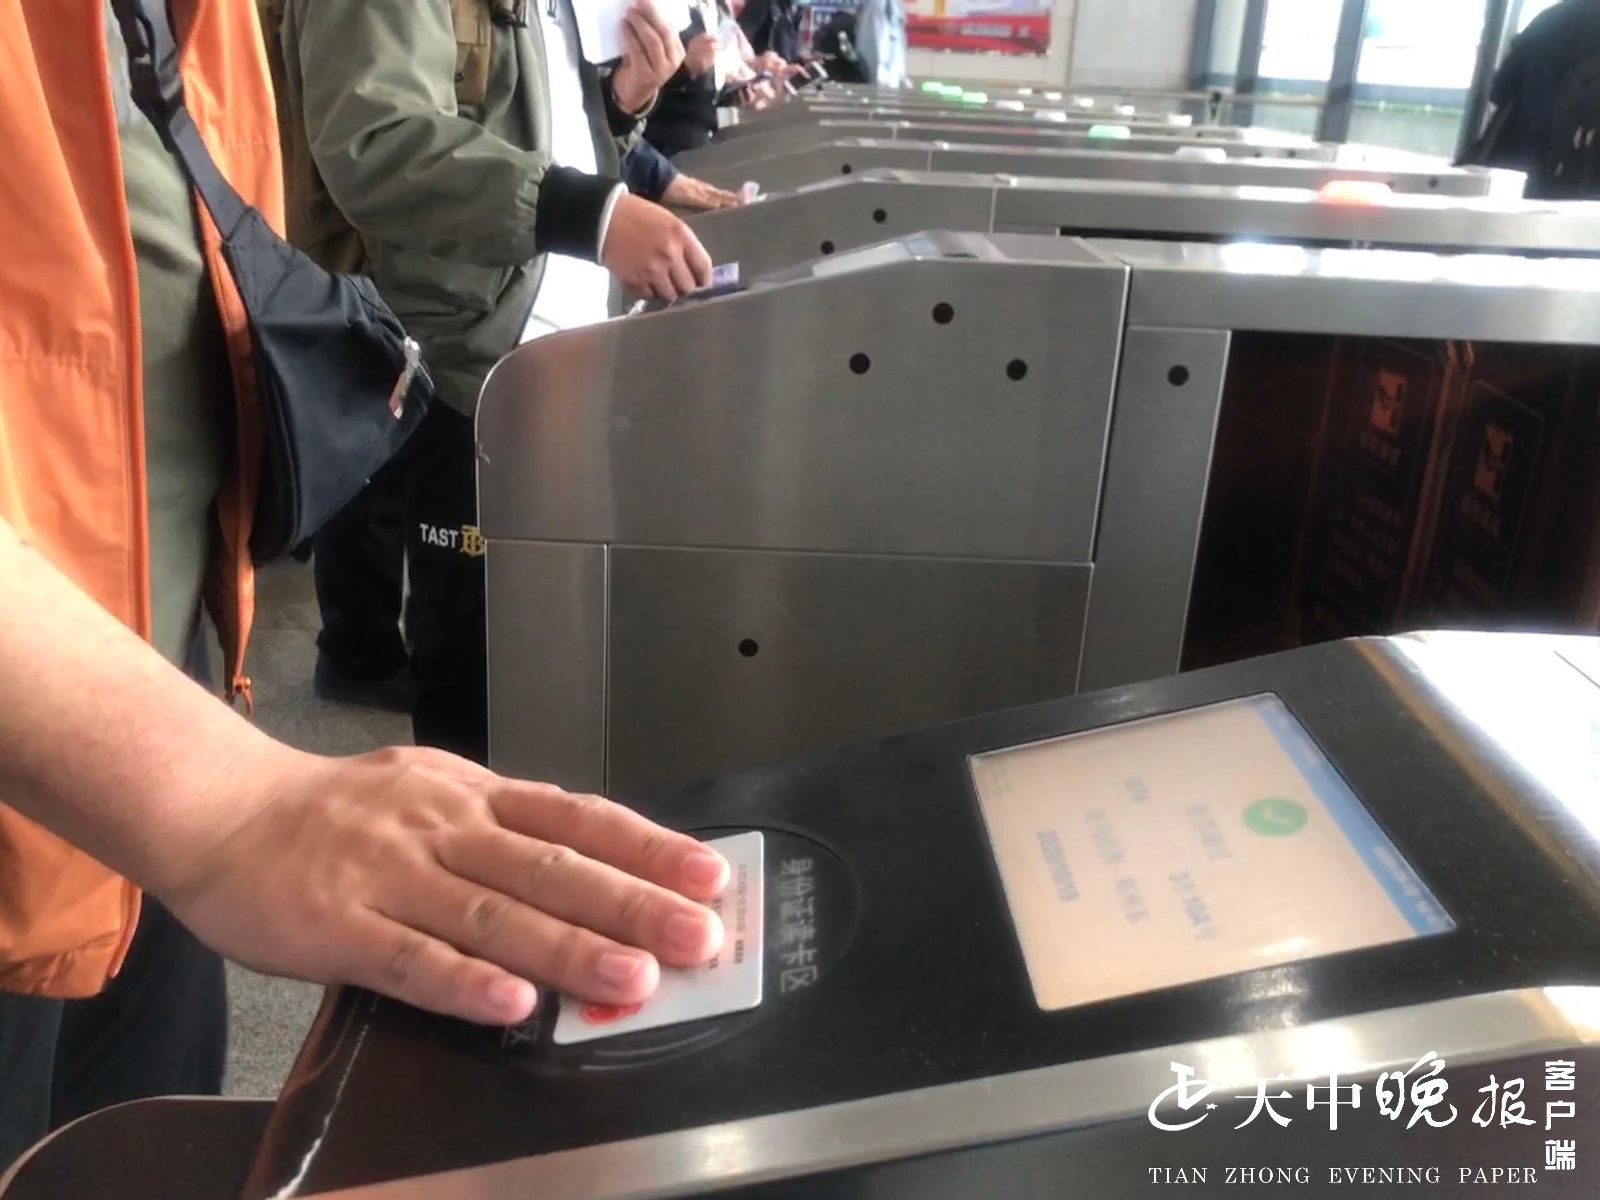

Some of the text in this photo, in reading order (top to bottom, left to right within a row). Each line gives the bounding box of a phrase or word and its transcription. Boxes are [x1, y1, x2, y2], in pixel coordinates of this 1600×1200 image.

[419, 523, 459, 548] TAST
[778, 857, 818, 993] 身份证读卡区
